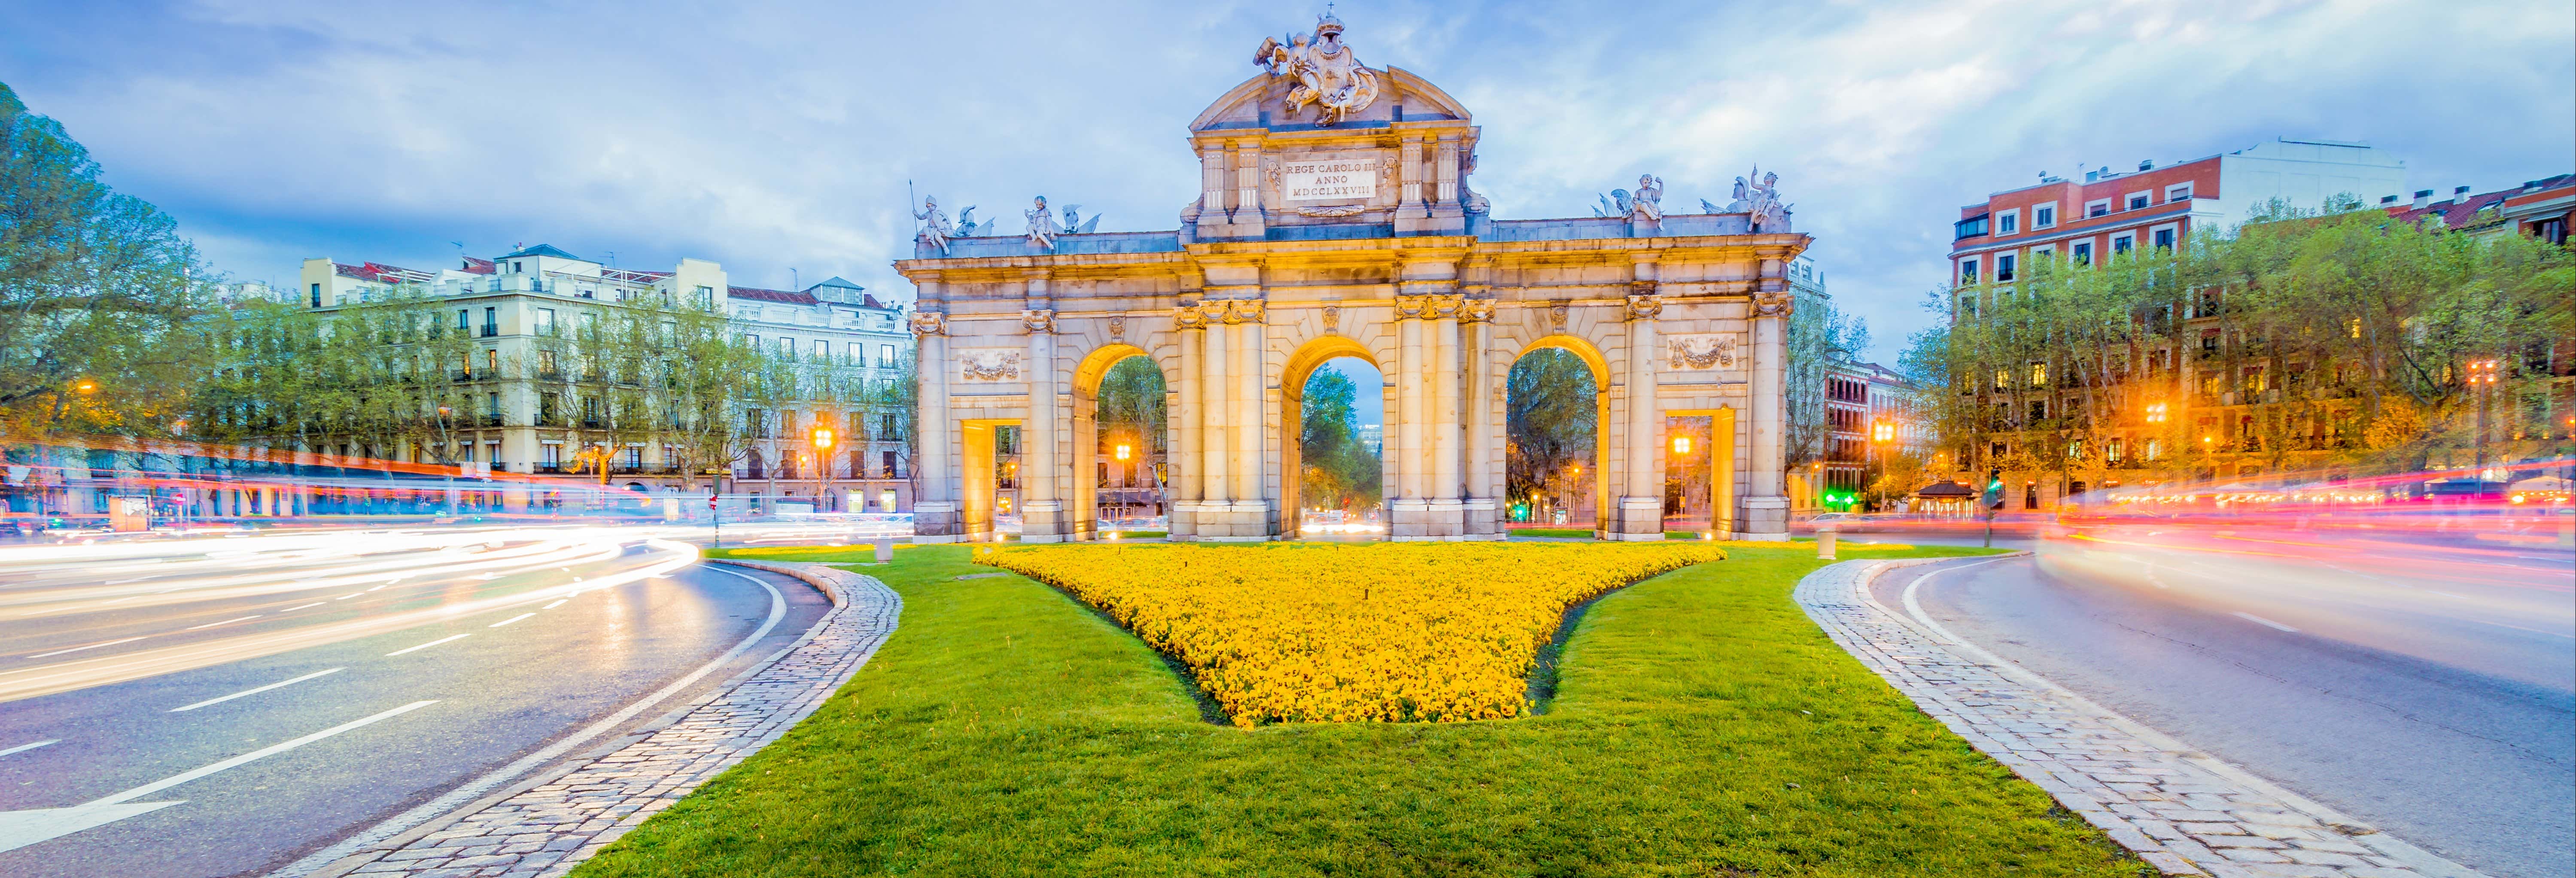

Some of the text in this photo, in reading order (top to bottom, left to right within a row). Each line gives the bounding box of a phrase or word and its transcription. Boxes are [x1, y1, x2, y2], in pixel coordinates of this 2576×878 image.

[1286, 163, 1376, 174] REGE CAROLO III
[1315, 176, 1347, 184] ANNO
[1293, 186, 1369, 196] MDCCLXXVIII
